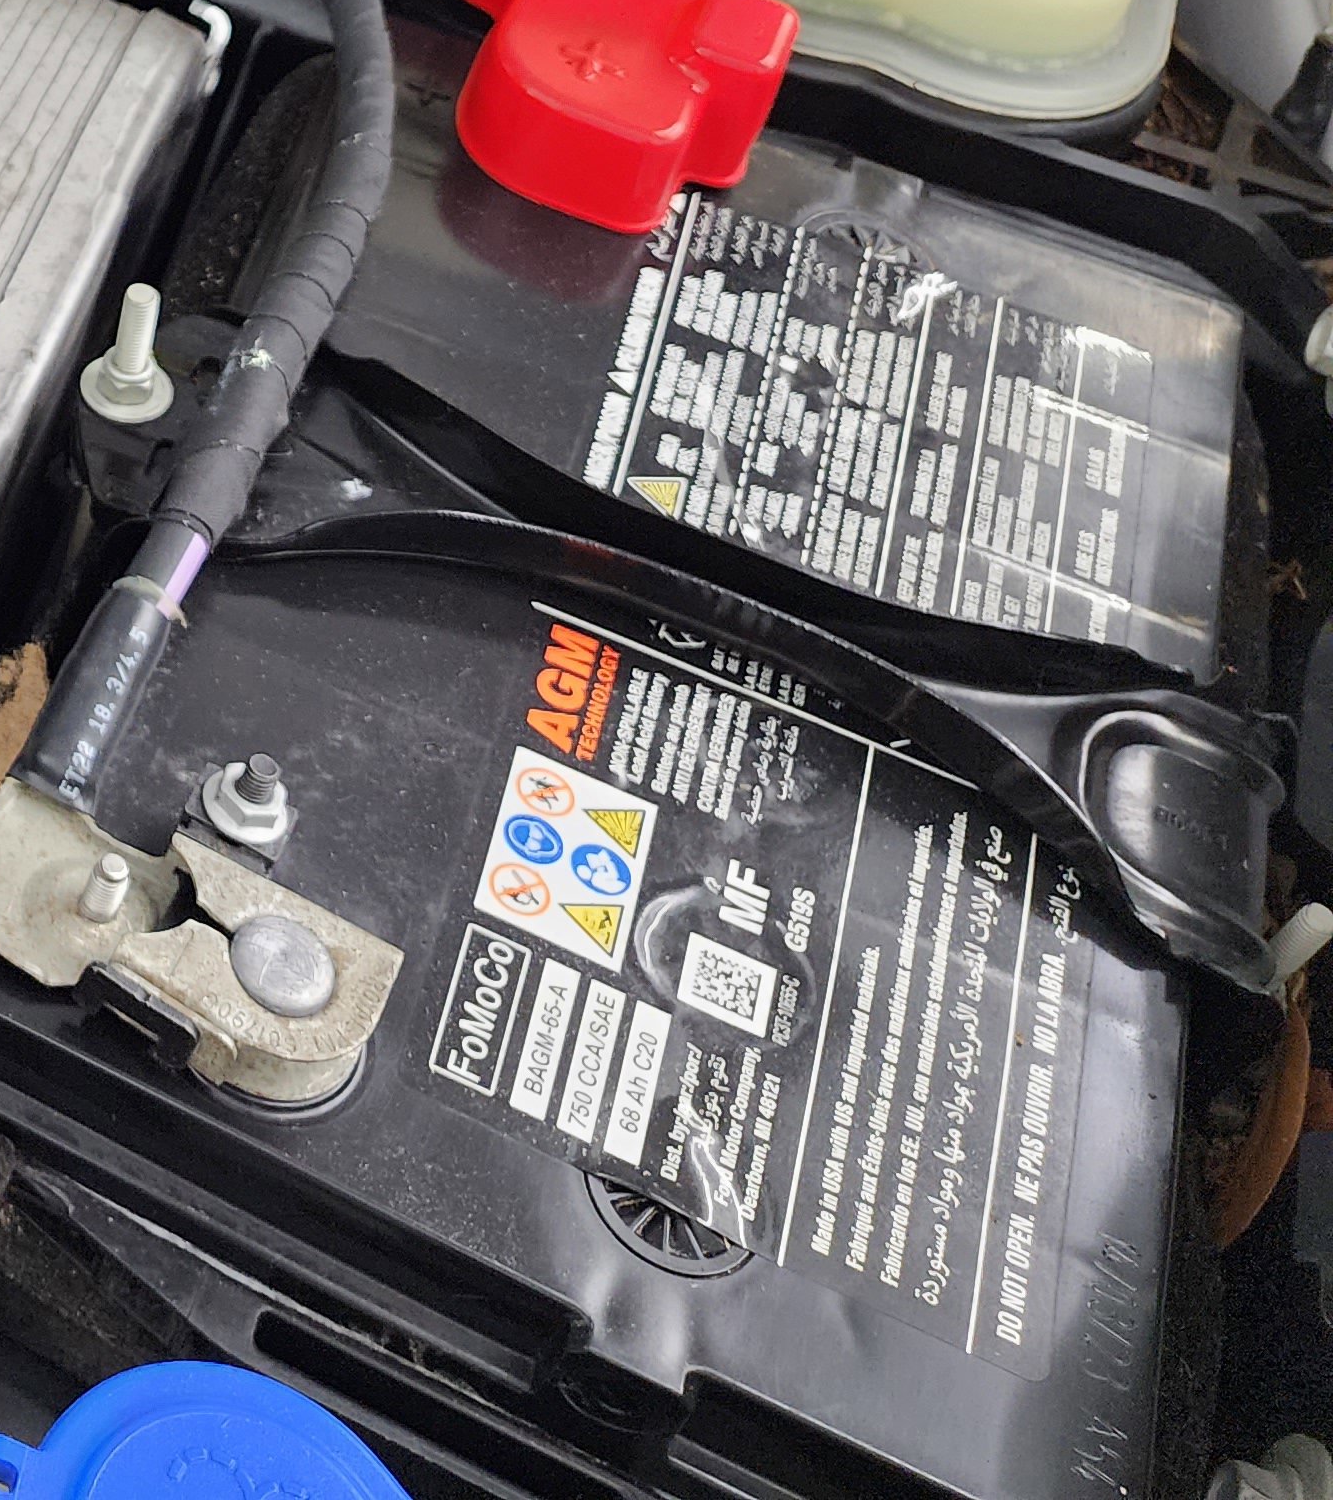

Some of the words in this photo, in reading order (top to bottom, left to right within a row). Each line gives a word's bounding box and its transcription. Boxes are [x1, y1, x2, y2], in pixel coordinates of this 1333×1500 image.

[527, 625, 597, 752] AGM
[575, 646, 618, 761] TECHNOLOGY
[640, 672, 670, 720] Battery
[608, 668, 648, 778] NON-SPILLABLE
[634, 716, 657, 750] Acid
[649, 740, 678, 795] Batterie
[667, 683, 691, 728] plomb
[624, 746, 649, 784] Lead
[907, 824, 933, 883] importés.
[940, 811, 967, 884] importados.
[983, 825, 1012, 865] صنع
[906, 879, 924, 898] et
[974, 859, 1009, 882] في
[718, 859, 769, 934] MF
[783, 886, 815, 952] G519S
[967, 875, 1002, 943] الولايات
[896, 896, 922, 970] américains
[926, 892, 956, 1001] estadounidenses
[856, 946, 880, 1012] materials.
[958, 940, 988, 1002] المتحدة
[1037, 952, 1066, 1005] ABRA.
[447, 936, 514, 1082] FoMoCo
[887, 966, 911, 1037] matériaux
[1034, 1000, 1060, 1029] LA
[522, 984, 567, 1095] BAGM-65-A
[576, 992, 615, 1087] CCA/SAE
[631, 1030, 658, 1071] C20
[842, 1008, 870, 1075] imported
[879, 1034, 901, 1064] des
[916, 999, 941, 1075] materiales
[946, 1001, 983, 1079] الأمريكية
[1031, 1024, 1058, 1056] NO
[624, 1075, 648, 1107] Ah
[728, 1046, 761, 1120] Company,
[757, 1072, 781, 1119] 48121
[840, 1070, 859, 1104] and
[877, 1061, 897, 1099] avec
[912, 1072, 930, 1103] con
[941, 1080, 976, 1125] بمواد
[1022, 1063, 1053, 1136] OUVRIR.
[566, 1089, 593, 1128] 750
[618, 1105, 641, 1134] 68
[752, 1116, 772, 1141] MI
[832, 1100, 854, 1126] US
[903, 1104, 926, 1132] UU.
[718, 1118, 743, 1169] Motor
[828, 1124, 850, 1160] with
[856, 1092, 891, 1175] États-Unis
[899, 1134, 921, 1160] EE.
[932, 1127, 966, 1164] منها
[1016, 1133, 1045, 1176] PAS
[659, 1144, 683, 1182] Dist.
[736, 1143, 771, 1221] Dearborn,
[821, 1158, 844, 1193] USA
[894, 1156, 917, 1184] los
[817, 1191, 839, 1212] in
[859, 1171, 878, 1204] aux
[895, 1182, 912, 1205] en
[926, 1167, 963, 1220] ومواد
[1013, 1171, 1039, 1204] NE
[810, 1209, 835, 1256] Made
[844, 1200, 874, 1271] Fabriqué
[879, 1203, 909, 1287] Fabricardo
[1004, 1213, 1035, 1269] OPEN.
[914, 1223, 950, 1305] مستوردة
[999, 1265, 1027, 1313] NOT
[995, 1310, 1023, 1345] DO
